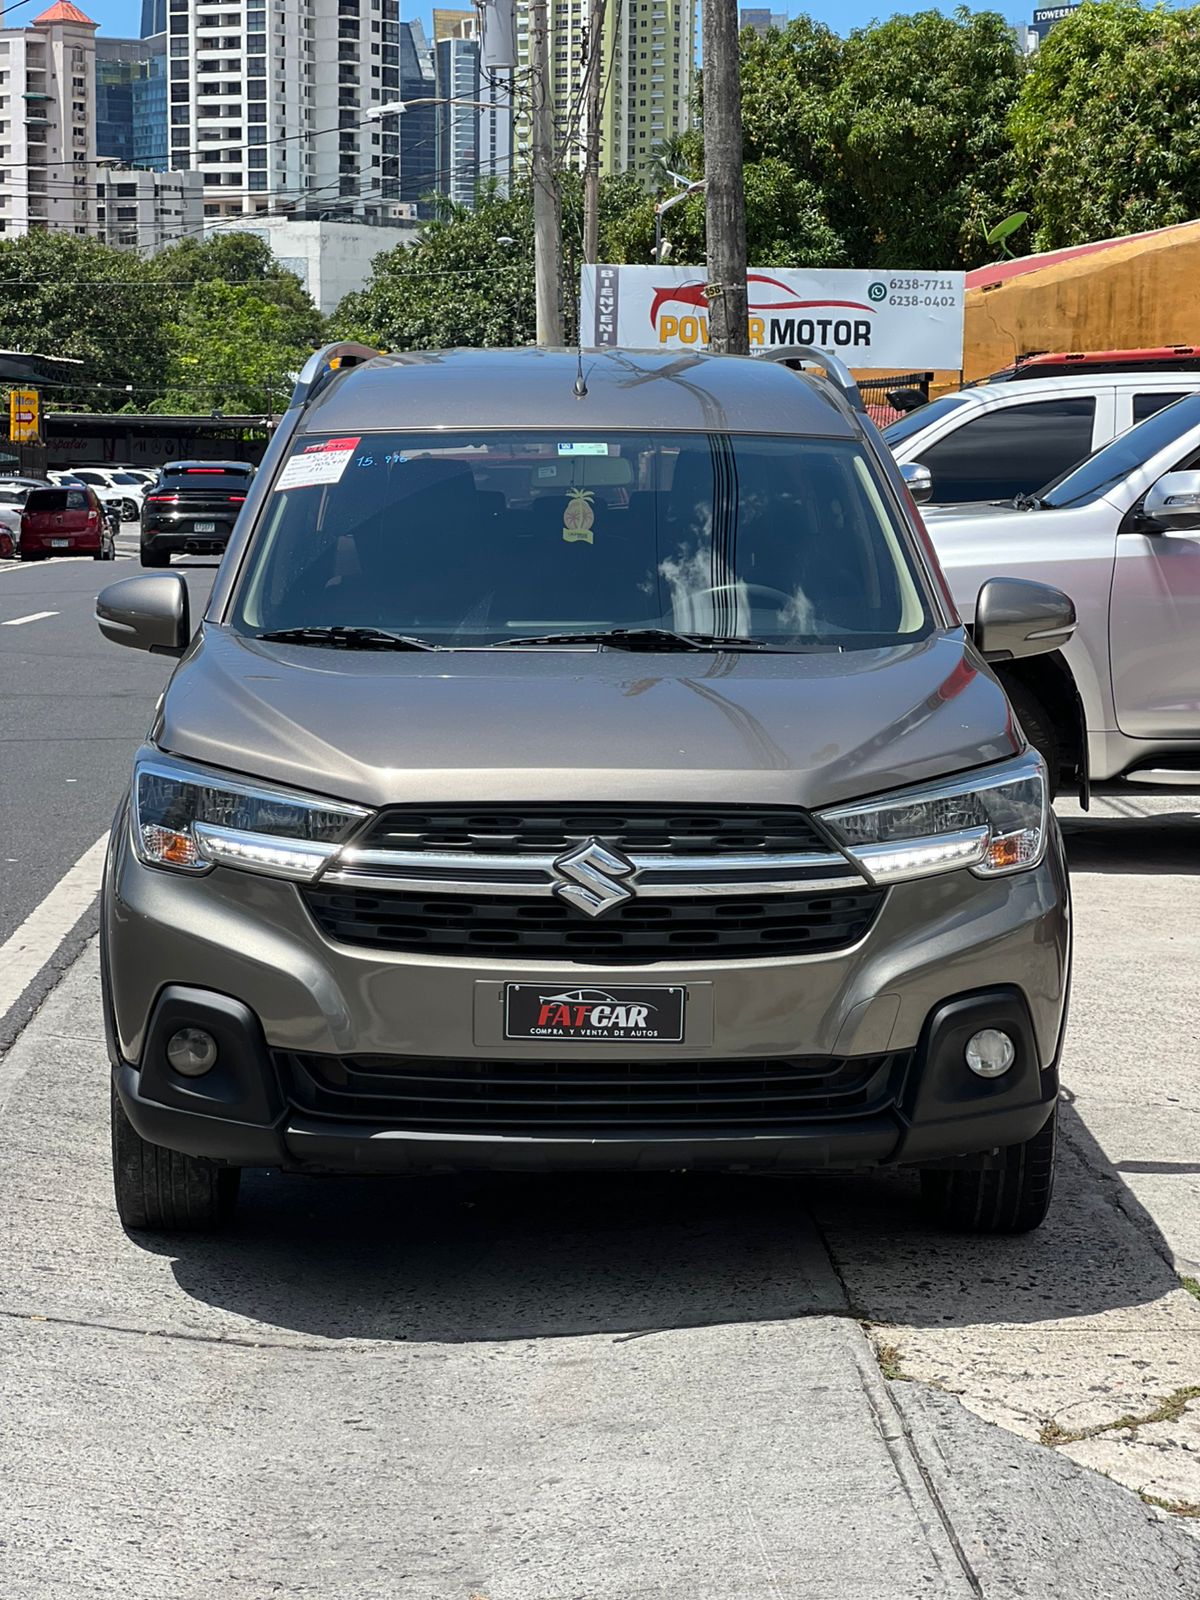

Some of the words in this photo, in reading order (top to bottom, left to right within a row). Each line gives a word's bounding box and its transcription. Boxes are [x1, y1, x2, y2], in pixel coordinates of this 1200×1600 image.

[889, 279, 953, 290] 6238-7711
[599, 270, 615, 345] BIENVENI
[889, 296, 956, 307] 6238-0402
[770, 318, 871, 347] MOTOR
[538, 1005, 648, 1027] FATCAR
[530, 1027, 564, 1035] COMPRA
